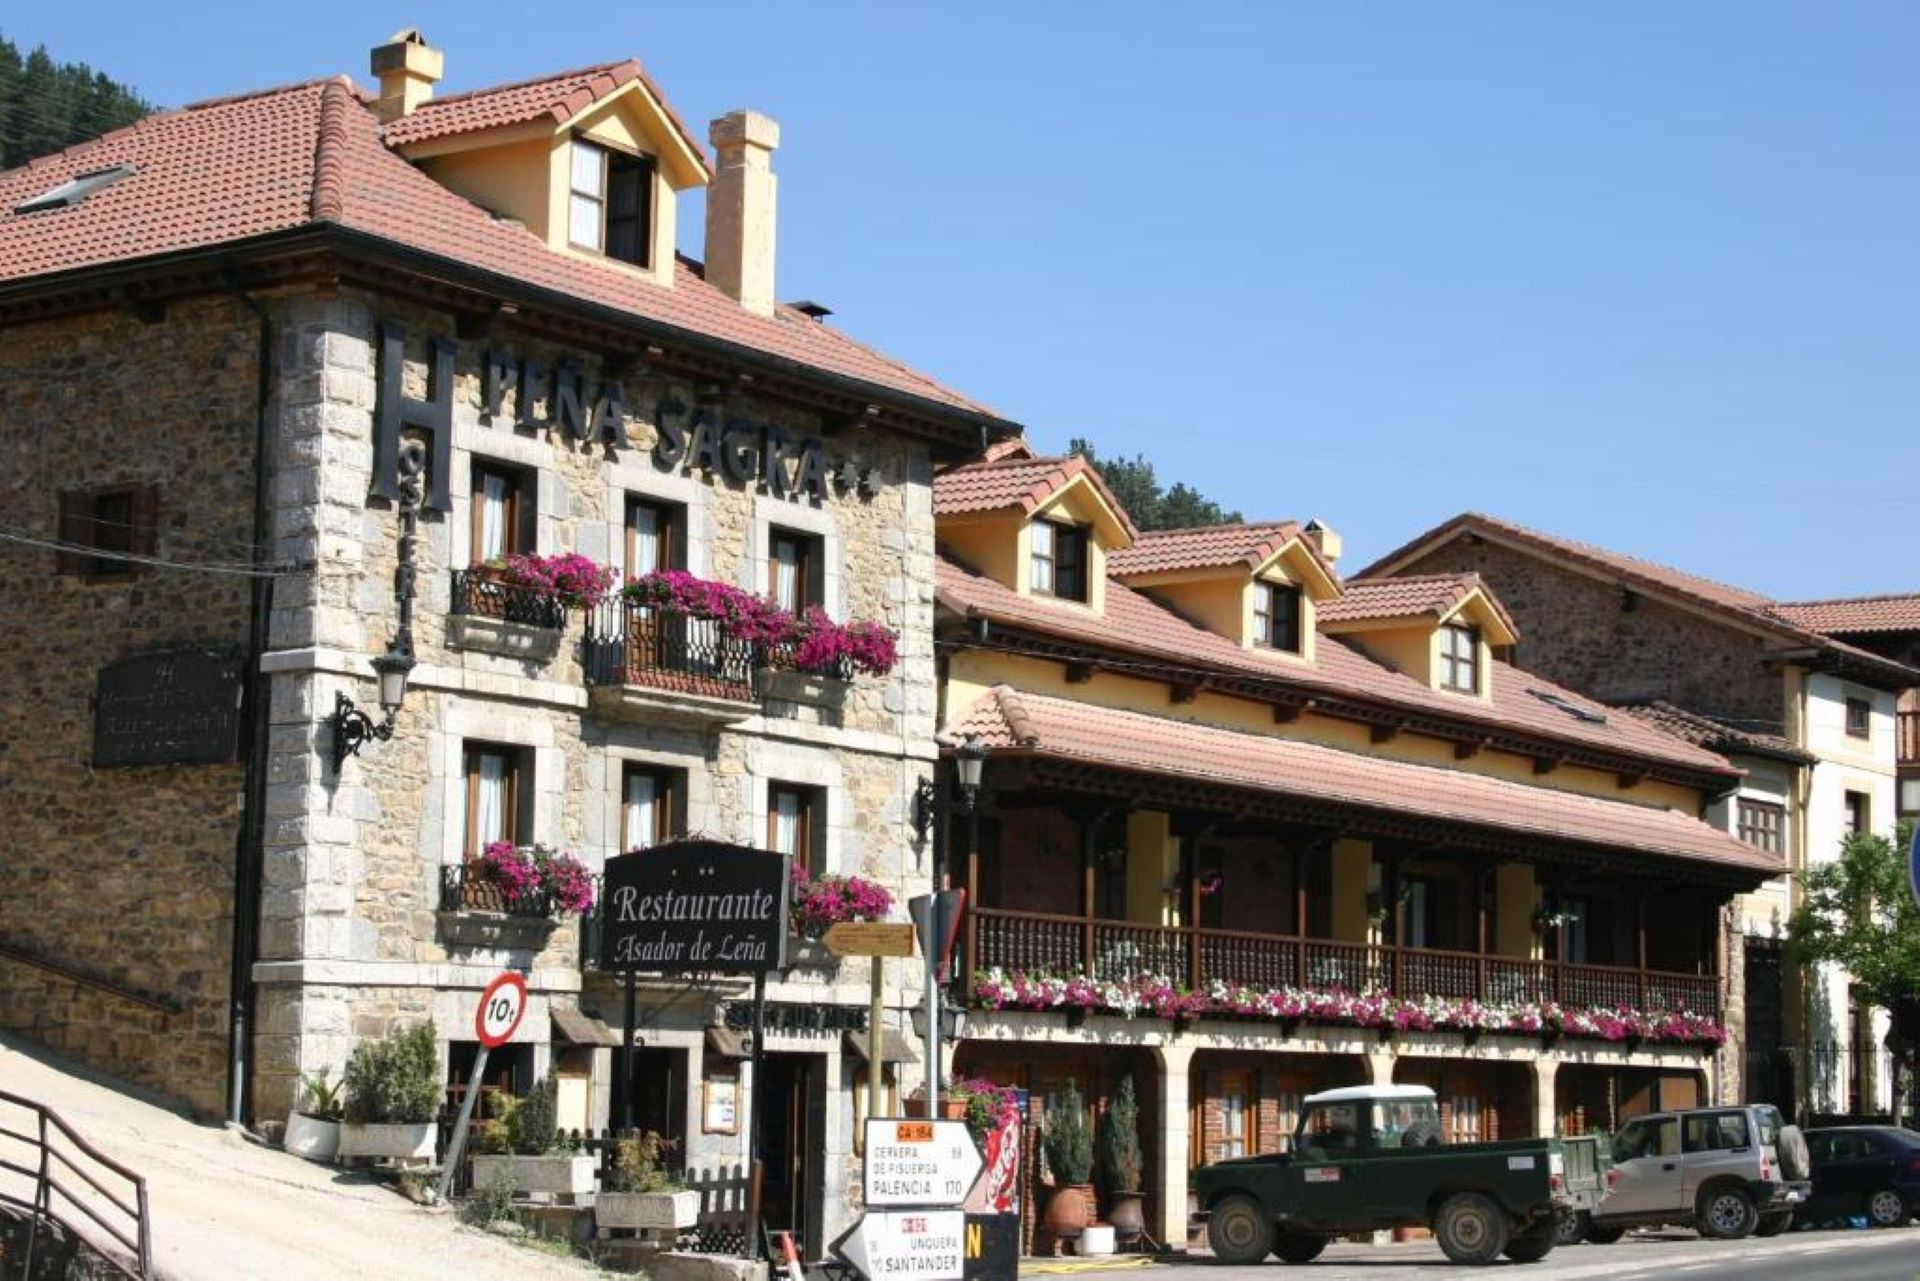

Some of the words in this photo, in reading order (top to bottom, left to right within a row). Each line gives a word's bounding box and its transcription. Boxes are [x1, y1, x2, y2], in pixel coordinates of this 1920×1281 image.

[613, 886, 773, 922] Restaurante
[614, 929, 684, 962] Asador
[690, 929, 711, 961] de
[715, 933, 766, 961] Leña
[874, 1146, 918, 1159] CERVERA
[873, 1162, 885, 1175] DE
[873, 1180, 931, 1195] PALENCIA
[945, 1180, 962, 1195] 170
[885, 1254, 957, 1272] SANTANDER
